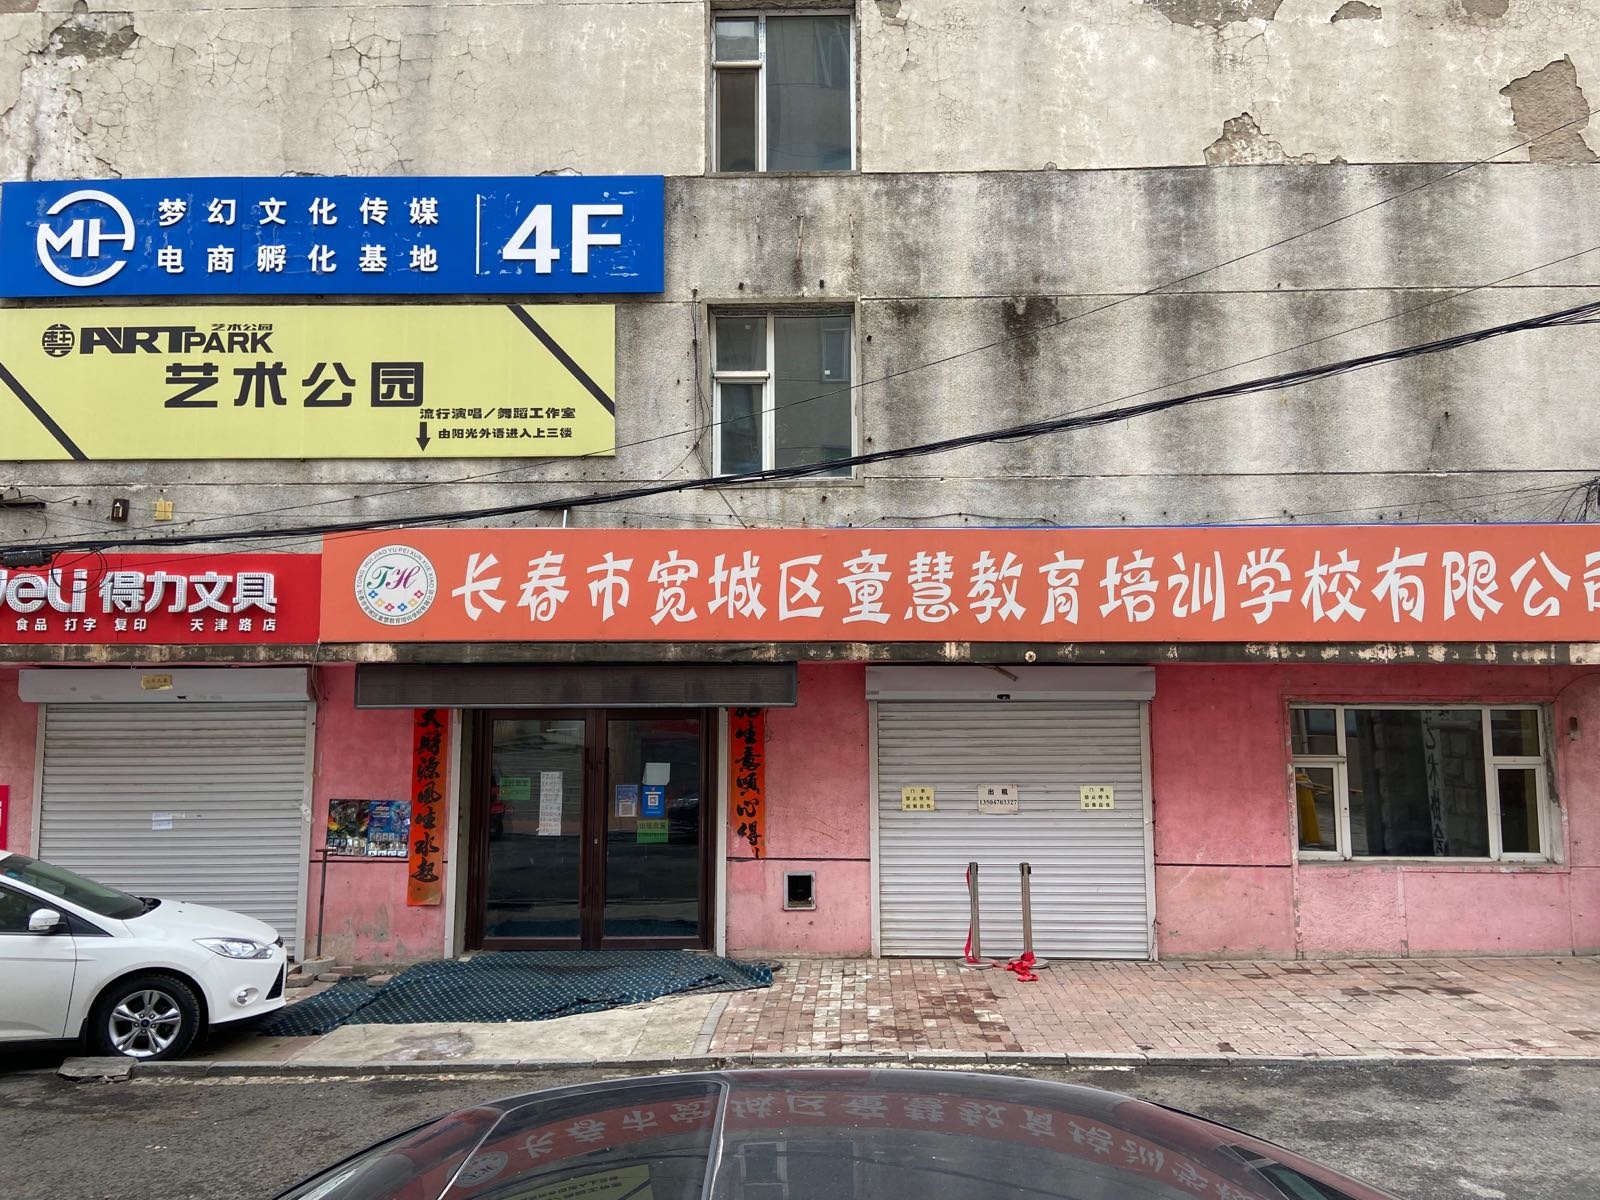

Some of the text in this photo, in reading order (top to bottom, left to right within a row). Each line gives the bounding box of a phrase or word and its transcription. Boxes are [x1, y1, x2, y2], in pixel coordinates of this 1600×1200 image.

[157, 197, 439, 227] 梦幻文化传媒
[503, 203, 624, 274] 4F
[157, 243, 439, 274] 电商孵化基地
[210, 323, 274, 331] 艺术公园
[163, 361, 425, 409] 艺术公园
[437, 427, 574, 439] 由阳光外语进入上三楼
[0, 568, 88, 613] eli
[98, 570, 278, 614] 得力文具
[15, 617, 277, 633] 食品 打字 复印 天津路店
[987, 788, 1009, 796] 出租
